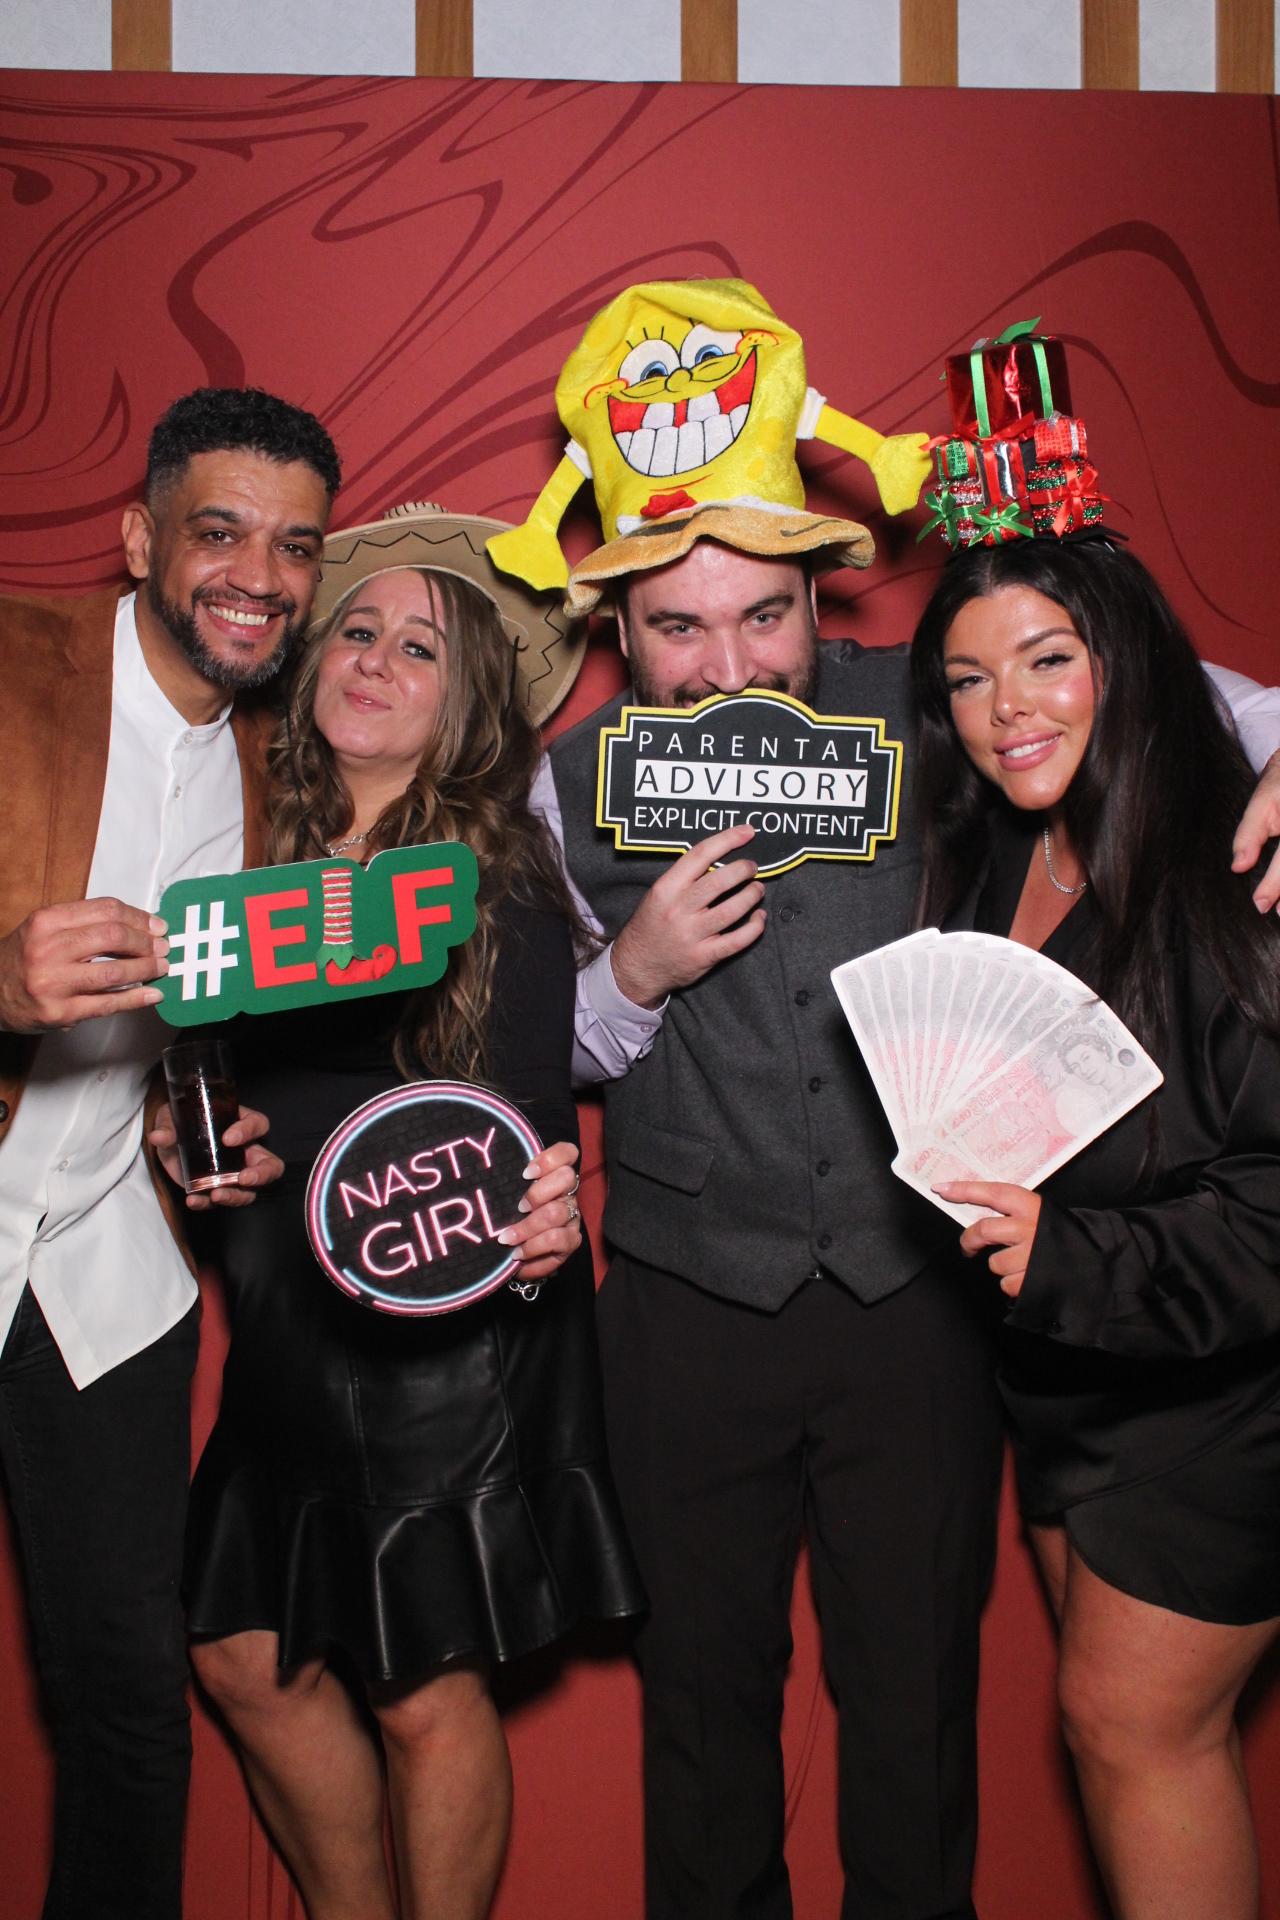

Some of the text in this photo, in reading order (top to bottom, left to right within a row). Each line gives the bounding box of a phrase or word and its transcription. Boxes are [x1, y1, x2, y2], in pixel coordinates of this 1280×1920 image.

[637, 731, 868, 763] PARENTAL
[636, 764, 867, 802] ADVISORY
[634, 806, 865, 837] EXPLICIT CONTENT
[339, 1127, 496, 1218] NASTY
[361, 1188, 511, 1276] GIRL
